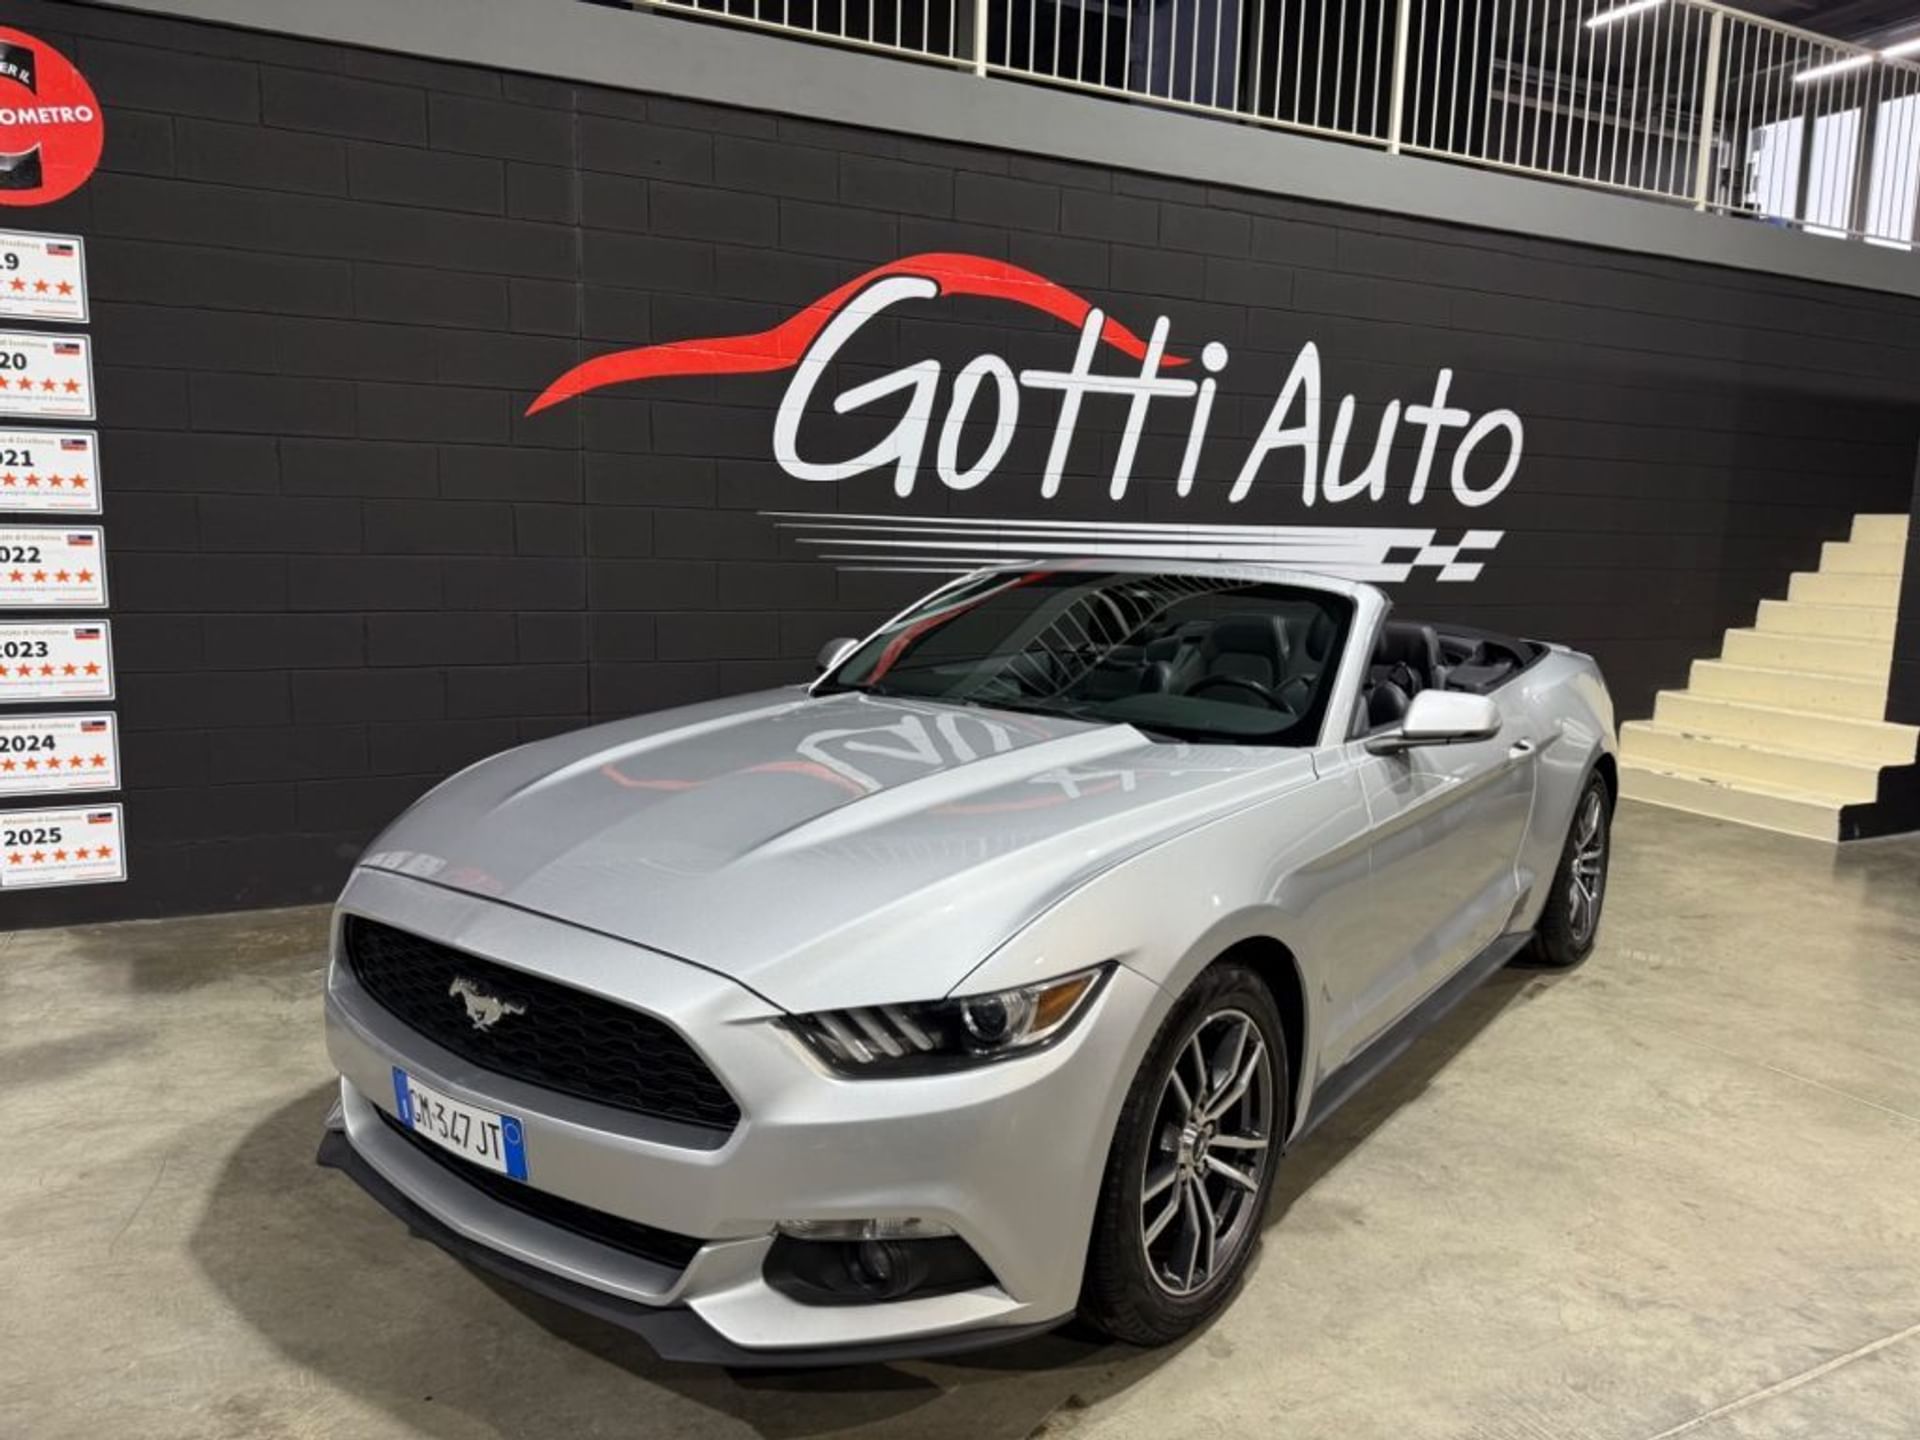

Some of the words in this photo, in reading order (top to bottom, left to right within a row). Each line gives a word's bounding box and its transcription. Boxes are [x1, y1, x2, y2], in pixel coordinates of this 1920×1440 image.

[773, 275, 1228, 500] Gotti
[1229, 341, 1523, 507] Auto
[0, 449, 34, 467] 21
[0, 641, 49, 658] 023
[0, 734, 56, 753] 2024
[4, 827, 62, 847] 2025
